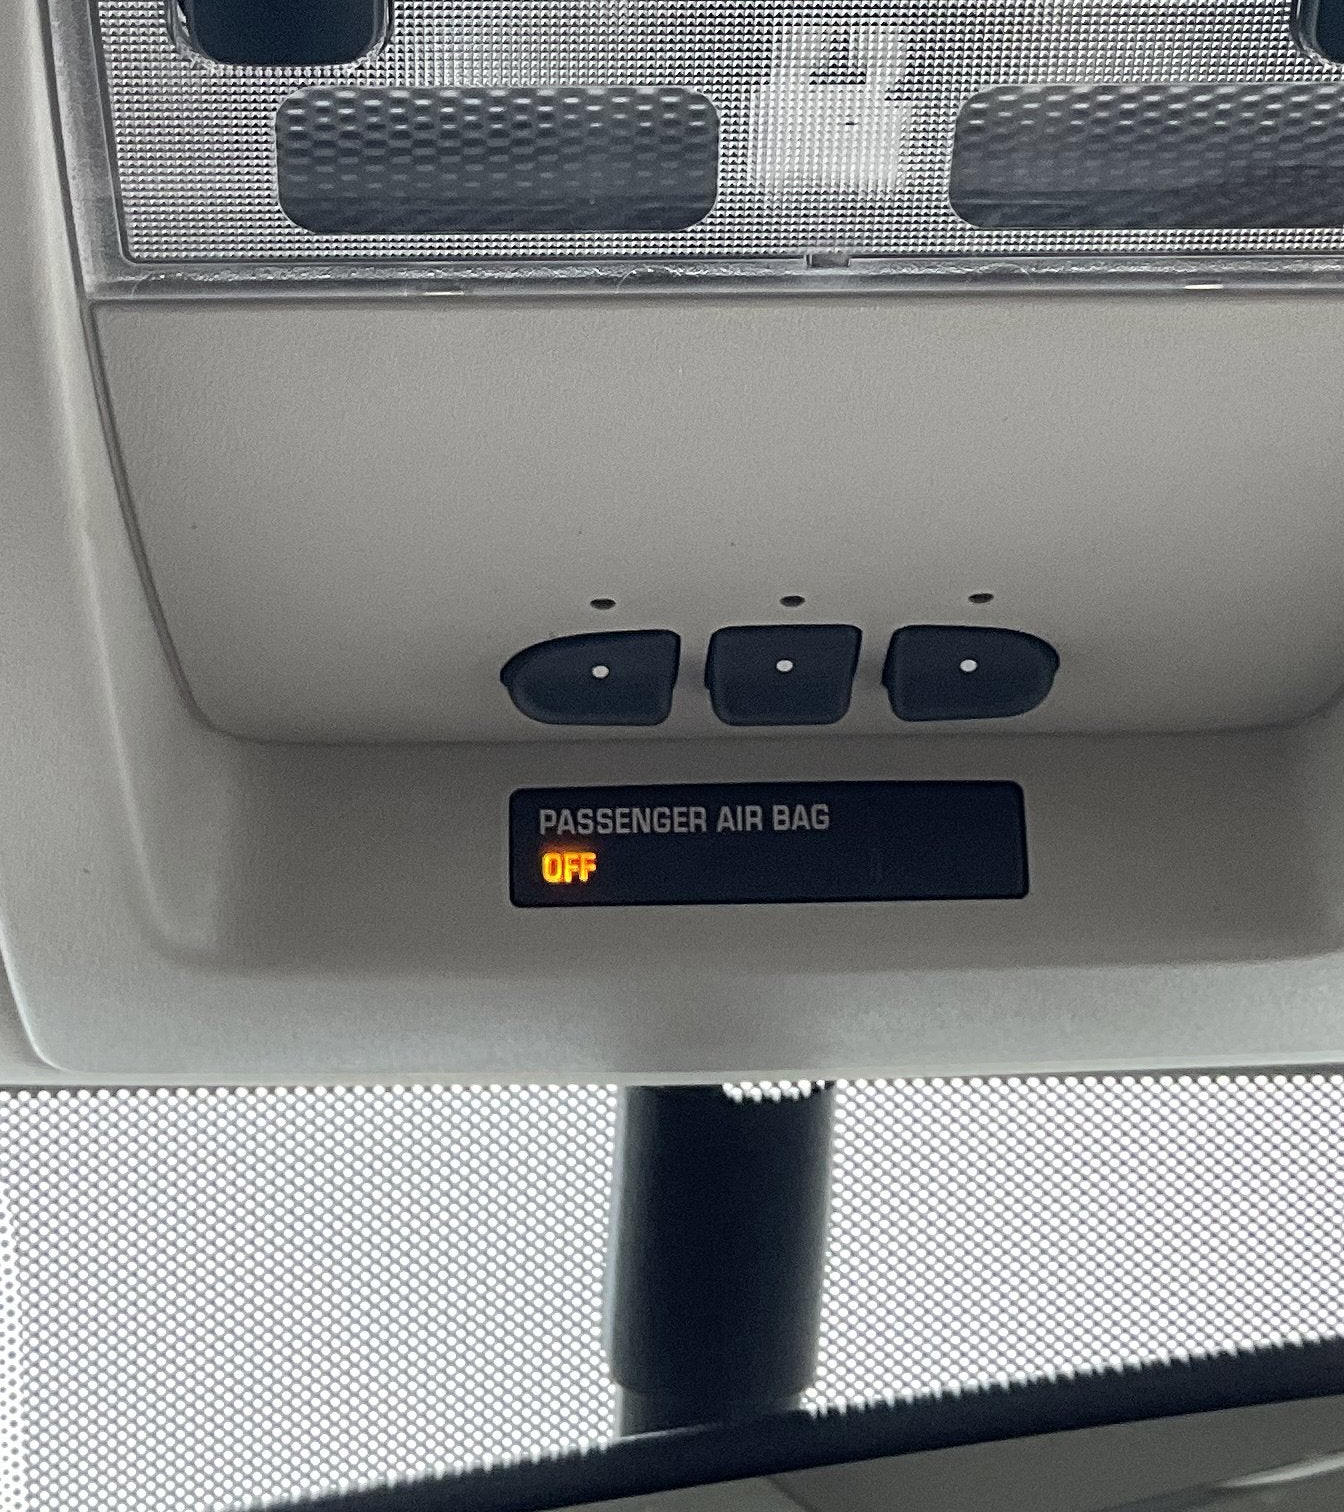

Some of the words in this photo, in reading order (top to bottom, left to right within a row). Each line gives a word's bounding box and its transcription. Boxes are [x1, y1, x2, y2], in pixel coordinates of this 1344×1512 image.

[540, 806, 707, 835] PASSENGER
[717, 805, 763, 833] AIR
[773, 804, 830, 831] BAG
[541, 851, 597, 884] OFF
